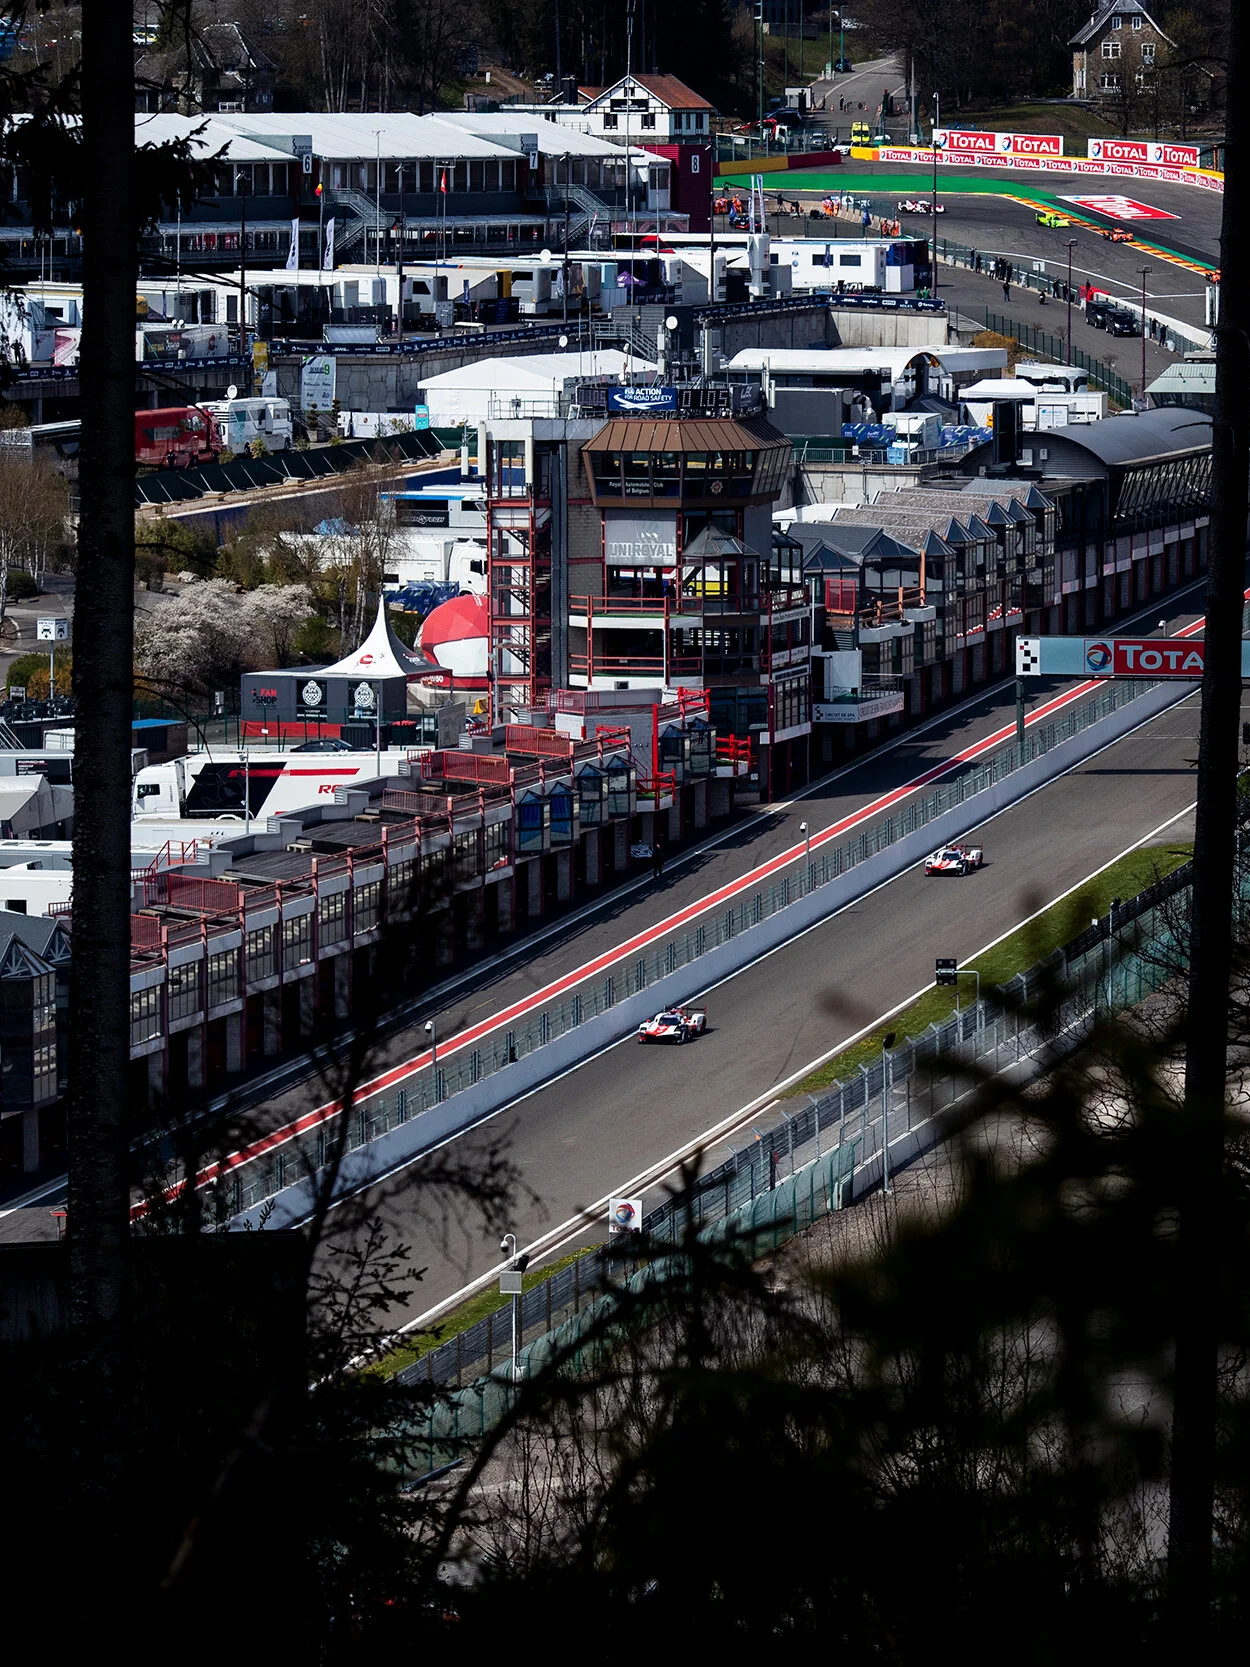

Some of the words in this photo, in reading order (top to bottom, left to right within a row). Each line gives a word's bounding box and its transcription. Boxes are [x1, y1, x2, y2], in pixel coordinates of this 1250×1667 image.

[950, 133, 994, 149] TOTAL
[1014, 137, 1058, 153] TOTAL
[1104, 143, 1147, 159] TOTAL
[1164, 147, 1196, 164] TOTAL
[305, 156, 310, 171] 6
[531, 152, 537, 167] 7
[693, 156, 698, 171] 8
[887, 151, 911, 160] TOTAL
[950, 155, 974, 163] TOTAL
[983, 157, 1007, 165] TOTAL
[1015, 159, 1039, 168] TOTAL
[1048, 161, 1071, 170] TOTAL
[1079, 163, 1104, 172] TOTAL
[1112, 165, 1133, 174] TOTAL
[1139, 168, 1158, 177] TOTAL
[324, 363, 330, 375] 9
[609, 542, 675, 558] UNIROYAL
[1118, 645, 1204, 670] TOTA
[256, 696, 277, 704] SHOP
[260, 688, 277, 697] FAN
